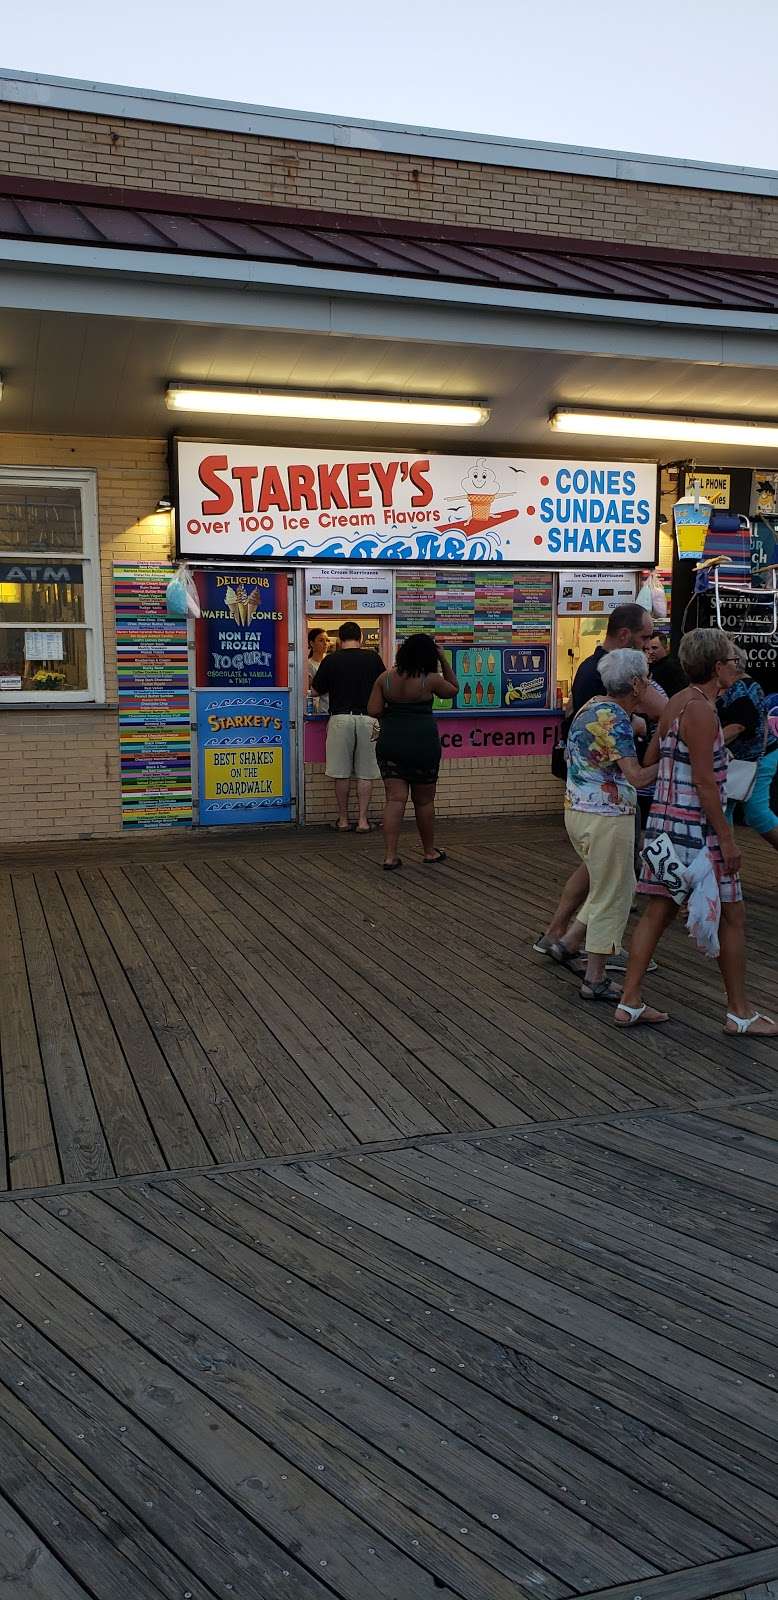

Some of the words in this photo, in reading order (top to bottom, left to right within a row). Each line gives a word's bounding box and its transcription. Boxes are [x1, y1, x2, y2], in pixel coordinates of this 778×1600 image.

[198, 455, 433, 516] STARKEY'S
[555, 468, 636, 495] CONES
[706, 478, 727, 489] PHONE
[539, 497, 650, 524] SUNDAES
[187, 519, 230, 535] Over
[239, 516, 274, 532] 100
[283, 515, 310, 530] Ice
[318, 512, 375, 529] Cream
[384, 508, 441, 525] Flavors
[547, 527, 642, 553] SHAKES
[6, 566, 71, 581] ATM
[216, 576, 270, 588] DELICIOUS
[201, 610, 235, 619] WAFFLE
[251, 611, 283, 620] CONES
[218, 631, 241, 640] NON
[245, 631, 261, 640] FAT
[221, 641, 260, 650] FROZEN
[212, 651, 272, 670] YOGURT
[746, 648, 777, 661] ACCO
[207, 714, 283, 733] STARKEY'S
[441, 733, 463, 748] ce
[470, 728, 535, 747] Cream
[213, 752, 237, 766] BEST
[239, 751, 274, 765] SHAKES
[231, 768, 242, 778] ON
[244, 767, 258, 778] THE
[216, 779, 273, 796] BOARDWALK
